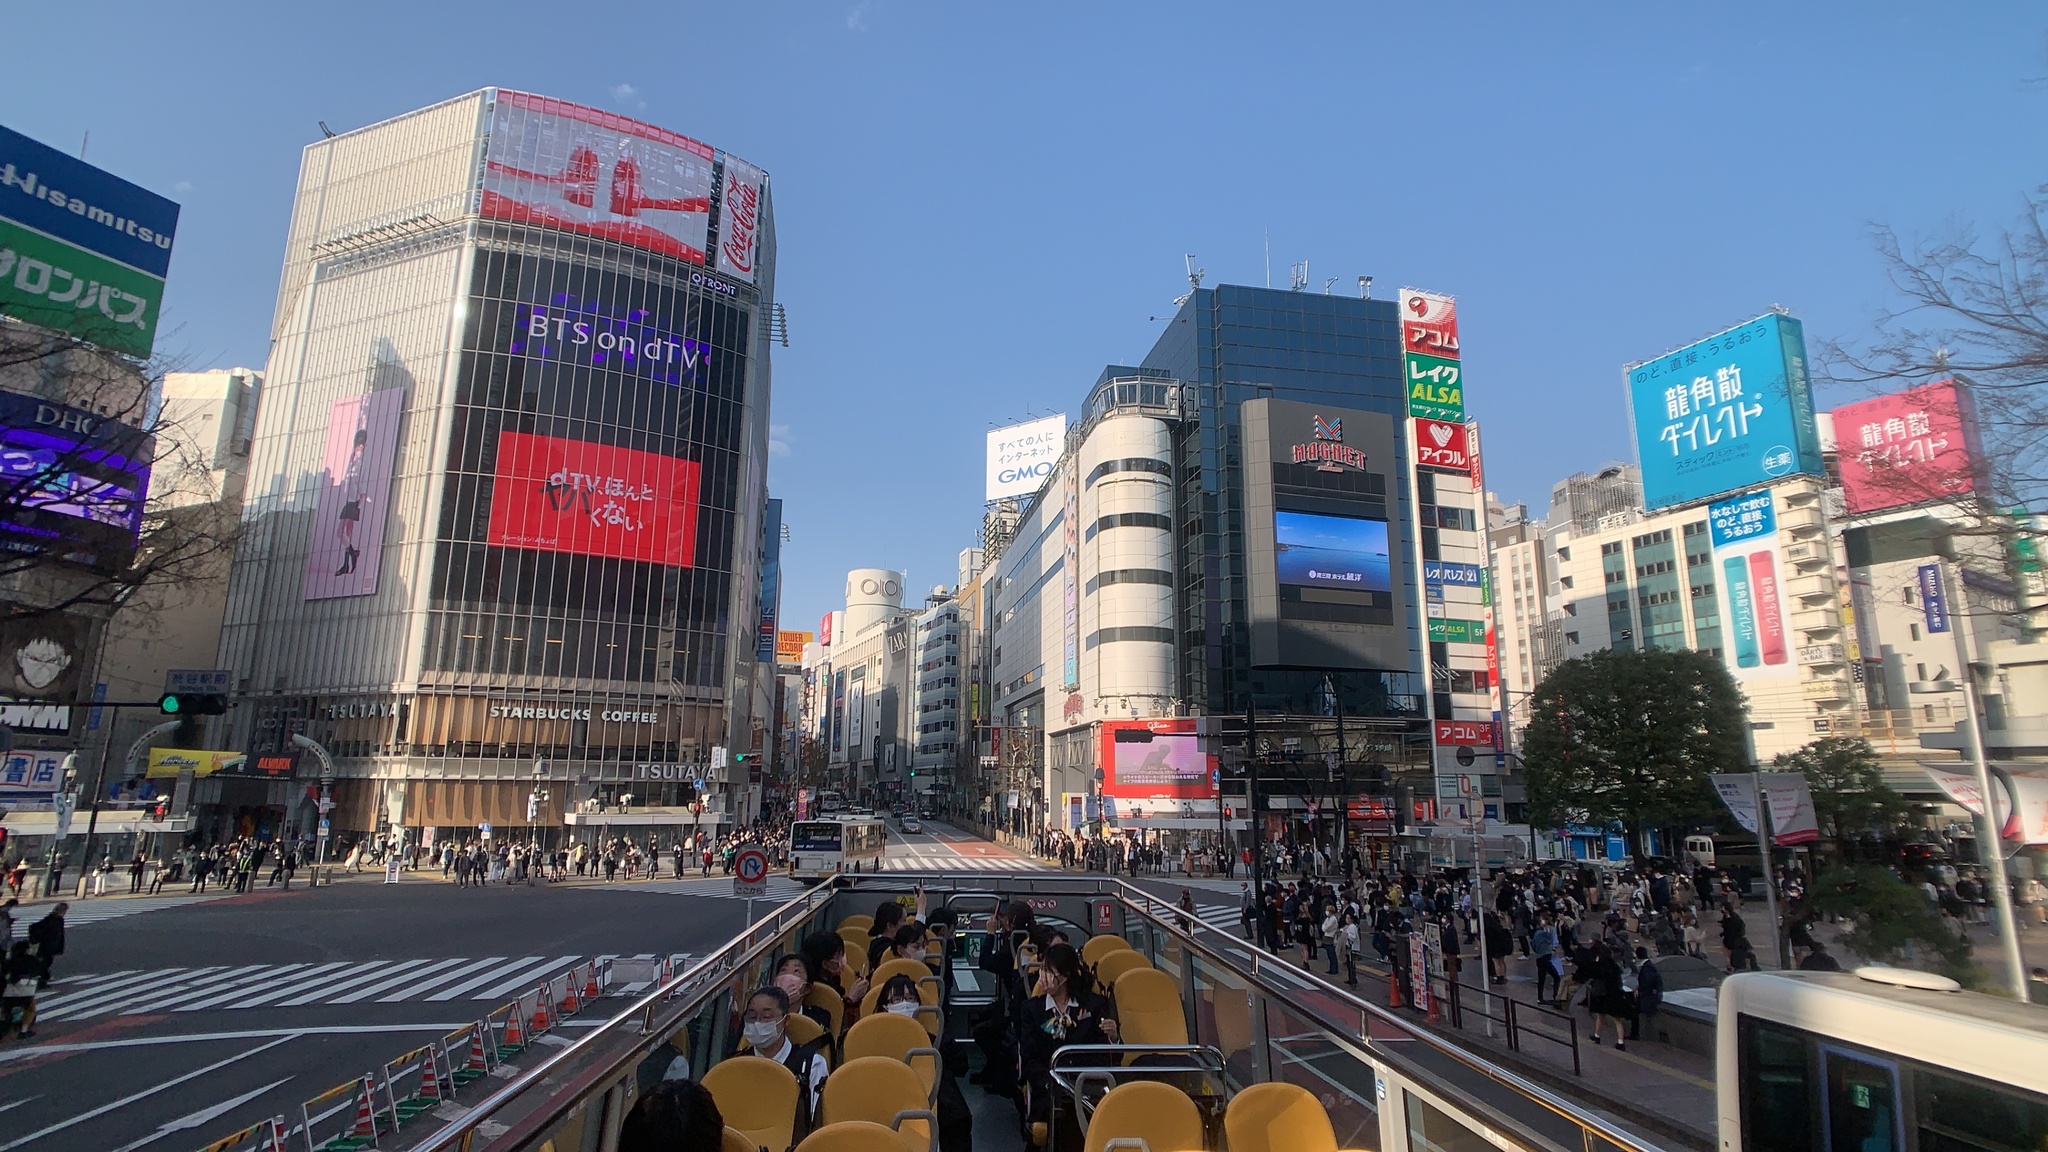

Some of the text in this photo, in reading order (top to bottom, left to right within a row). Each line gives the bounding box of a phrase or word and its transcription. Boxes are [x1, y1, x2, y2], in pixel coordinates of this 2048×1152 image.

[0, 163, 171, 250] Hisamitsu
[691, 272, 737, 296] QFRONT
[528, 313, 701, 369] BTS on dTV
[1409, 326, 1460, 351] アコム
[1636, 324, 1768, 384] のど、直接、うるおう
[1411, 361, 1459, 386] レイク
[1411, 382, 1463, 406] ALSA
[1664, 363, 1745, 421] 龍角散
[1659, 401, 1764, 458] ダイレクト
[1860, 411, 1932, 448] 龍角散
[998, 431, 1054, 453] すべての人に
[998, 445, 1054, 465] インターネット
[1293, 441, 1367, 471] MAGNET
[1419, 447, 1466, 466] アイフル
[1676, 451, 1715, 471] スティック
[1765, 452, 1792, 469] 生薬
[997, 461, 1053, 484] GMO
[1472, 463, 1481, 488] アイフル
[549, 467, 655, 502] dTV、ほんと
[1711, 496, 1771, 519] 水なしで飲む
[1717, 511, 1768, 529] のど、直接、
[1723, 523, 1764, 539] うるおう
[1425, 567, 1478, 582] レオパレス21
[1926, 569, 1938, 597] MIZUHO
[760, 607, 775, 652] SEIBU
[780, 632, 804, 642] TOWER
[1429, 624, 1446, 632] レイク
[1447, 625, 1466, 634] ALSA
[1474, 628, 1484, 637] 5F
[1487, 645, 1497, 669] アコム
[330, 702, 398, 719] TSUTAYA
[489, 706, 659, 724] STARBUCKS COFFEE
[1440, 726, 1477, 740] アコム
[1479, 723, 1491, 733] 3F
[5, 757, 57, 783] 書店
[638, 764, 717, 781] TSUTAYA
[736, 887, 764, 895] ここから
